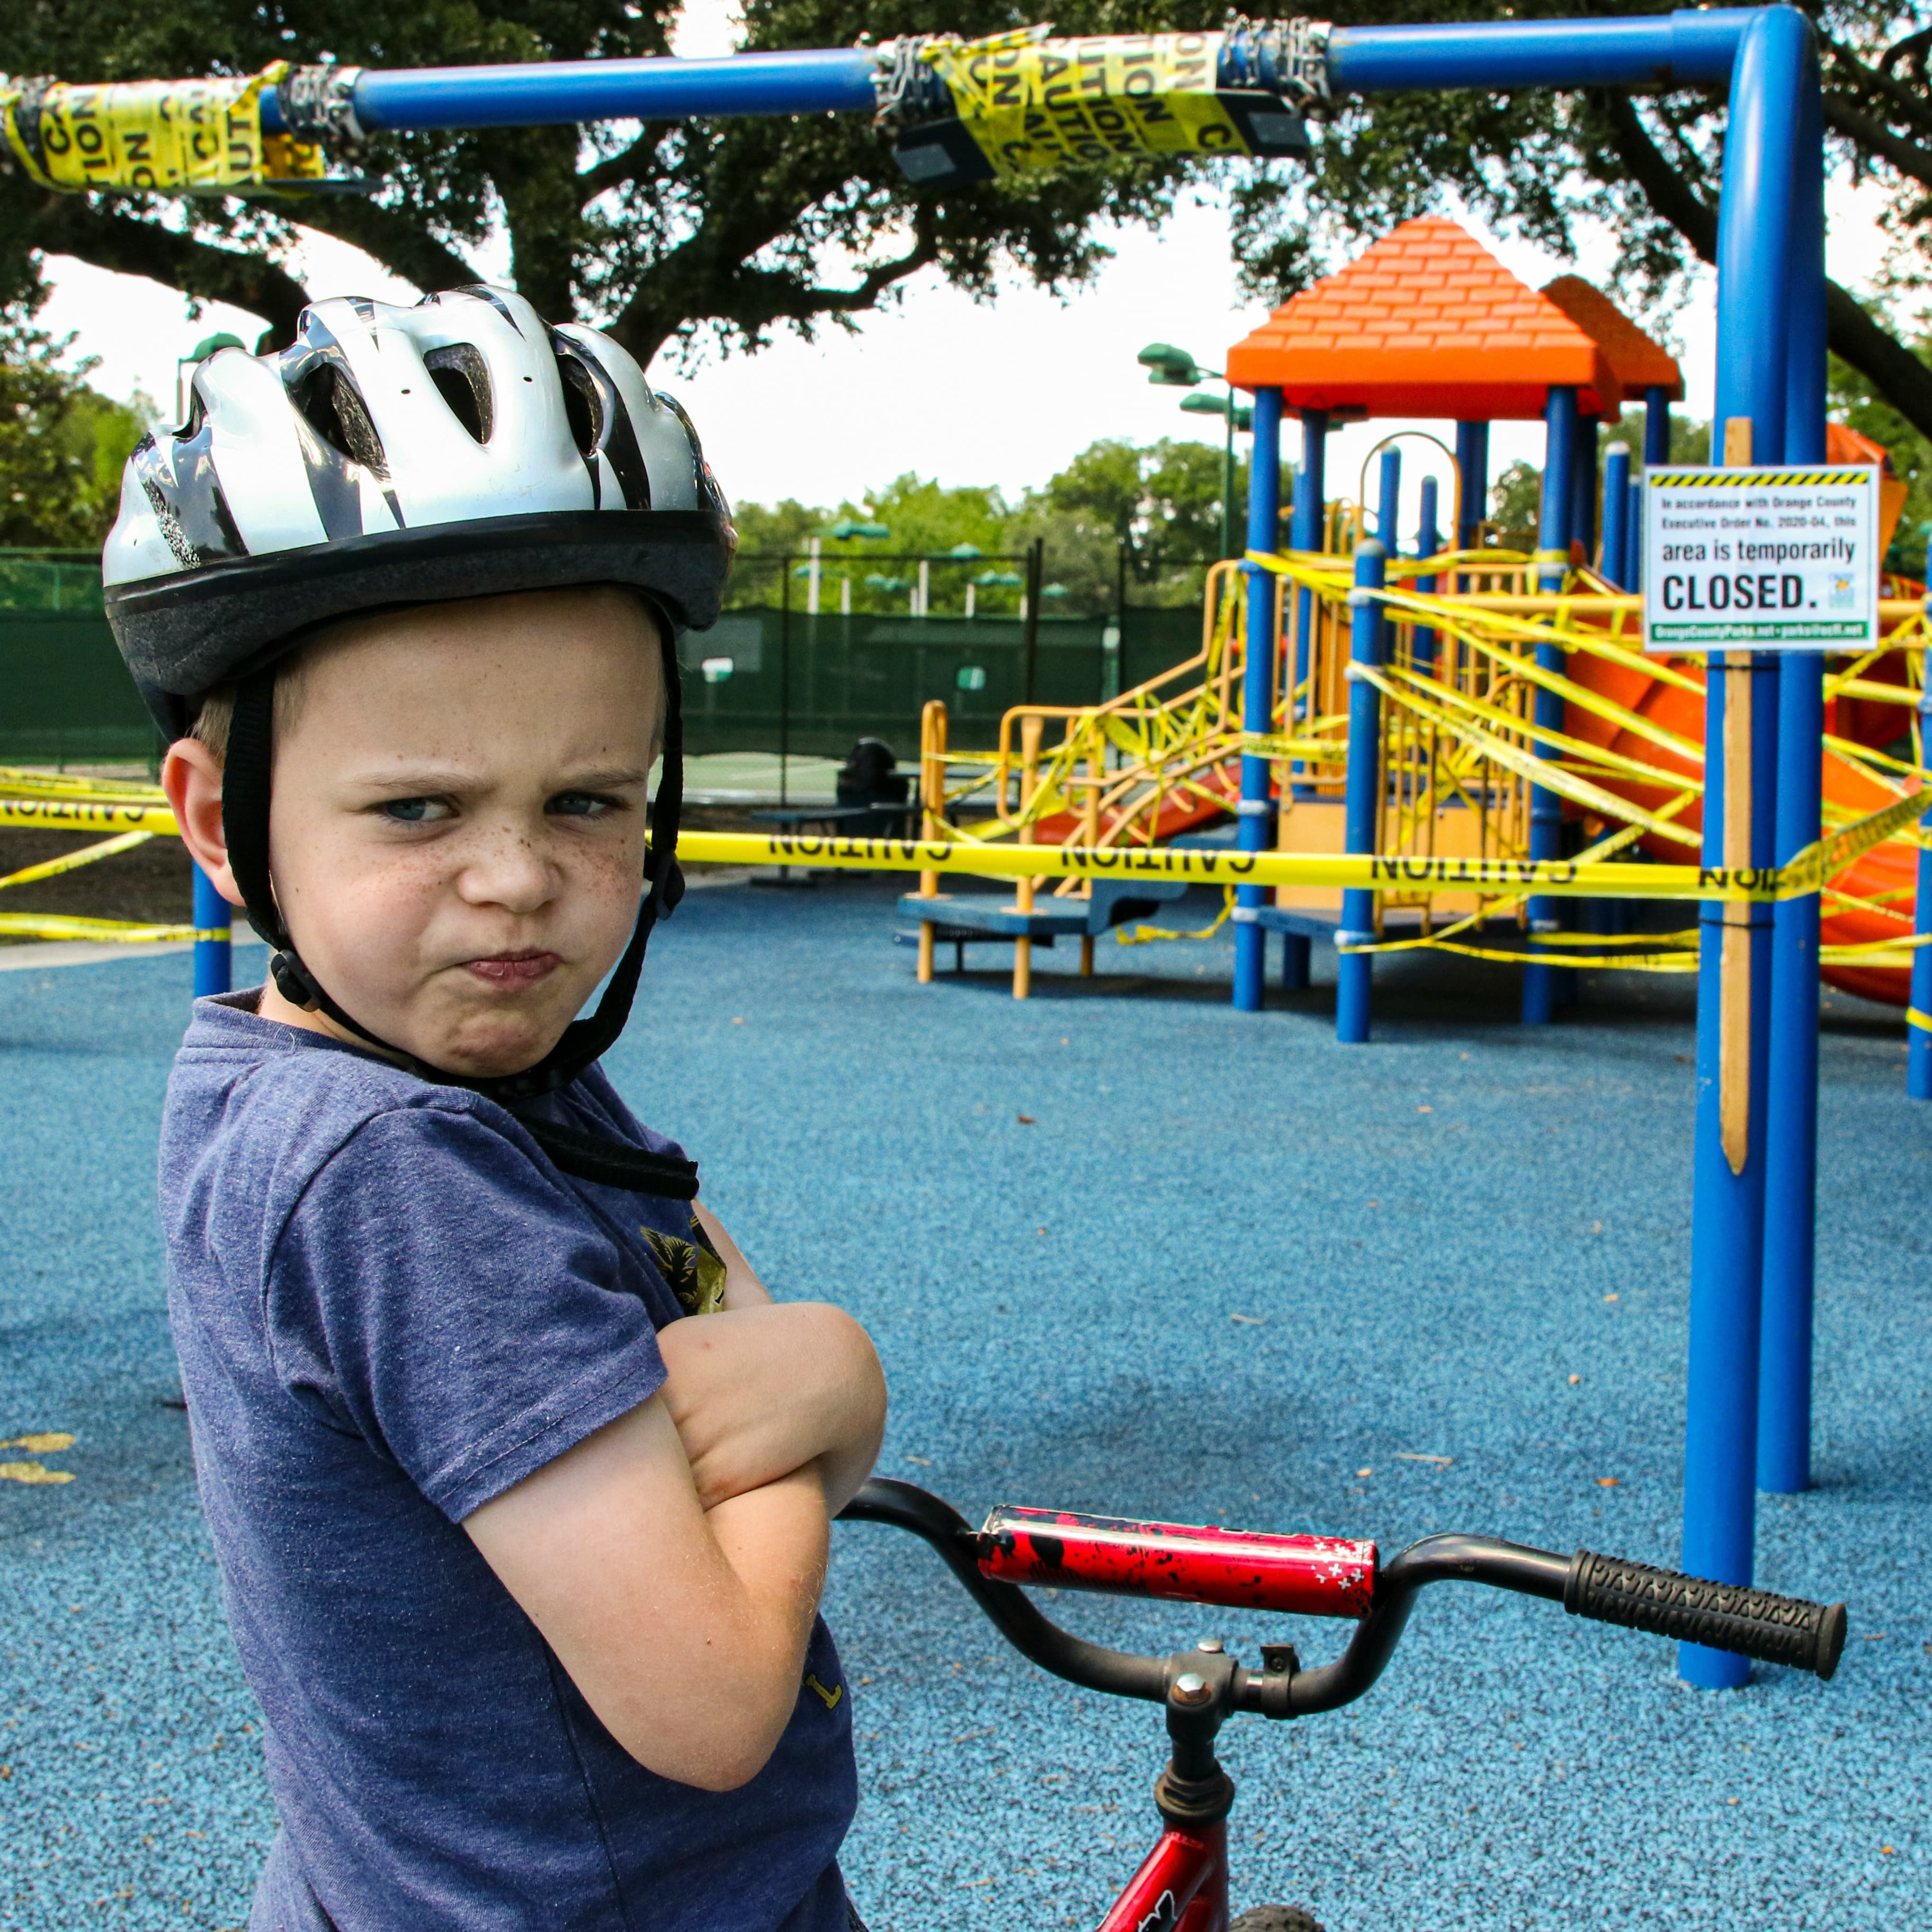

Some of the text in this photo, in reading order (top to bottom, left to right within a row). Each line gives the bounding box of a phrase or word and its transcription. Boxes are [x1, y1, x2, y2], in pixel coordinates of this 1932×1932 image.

[1746, 496, 1768, 508] with
[1773, 496, 1812, 510] Orange
[1817, 495, 1857, 509] County
[1661, 518, 1716, 529] Executive
[1721, 517, 1751, 529] Order
[1835, 516, 1857, 527] this
[1663, 536, 1855, 565] area is temporarily
[1663, 574, 1818, 610] CLOSED.
